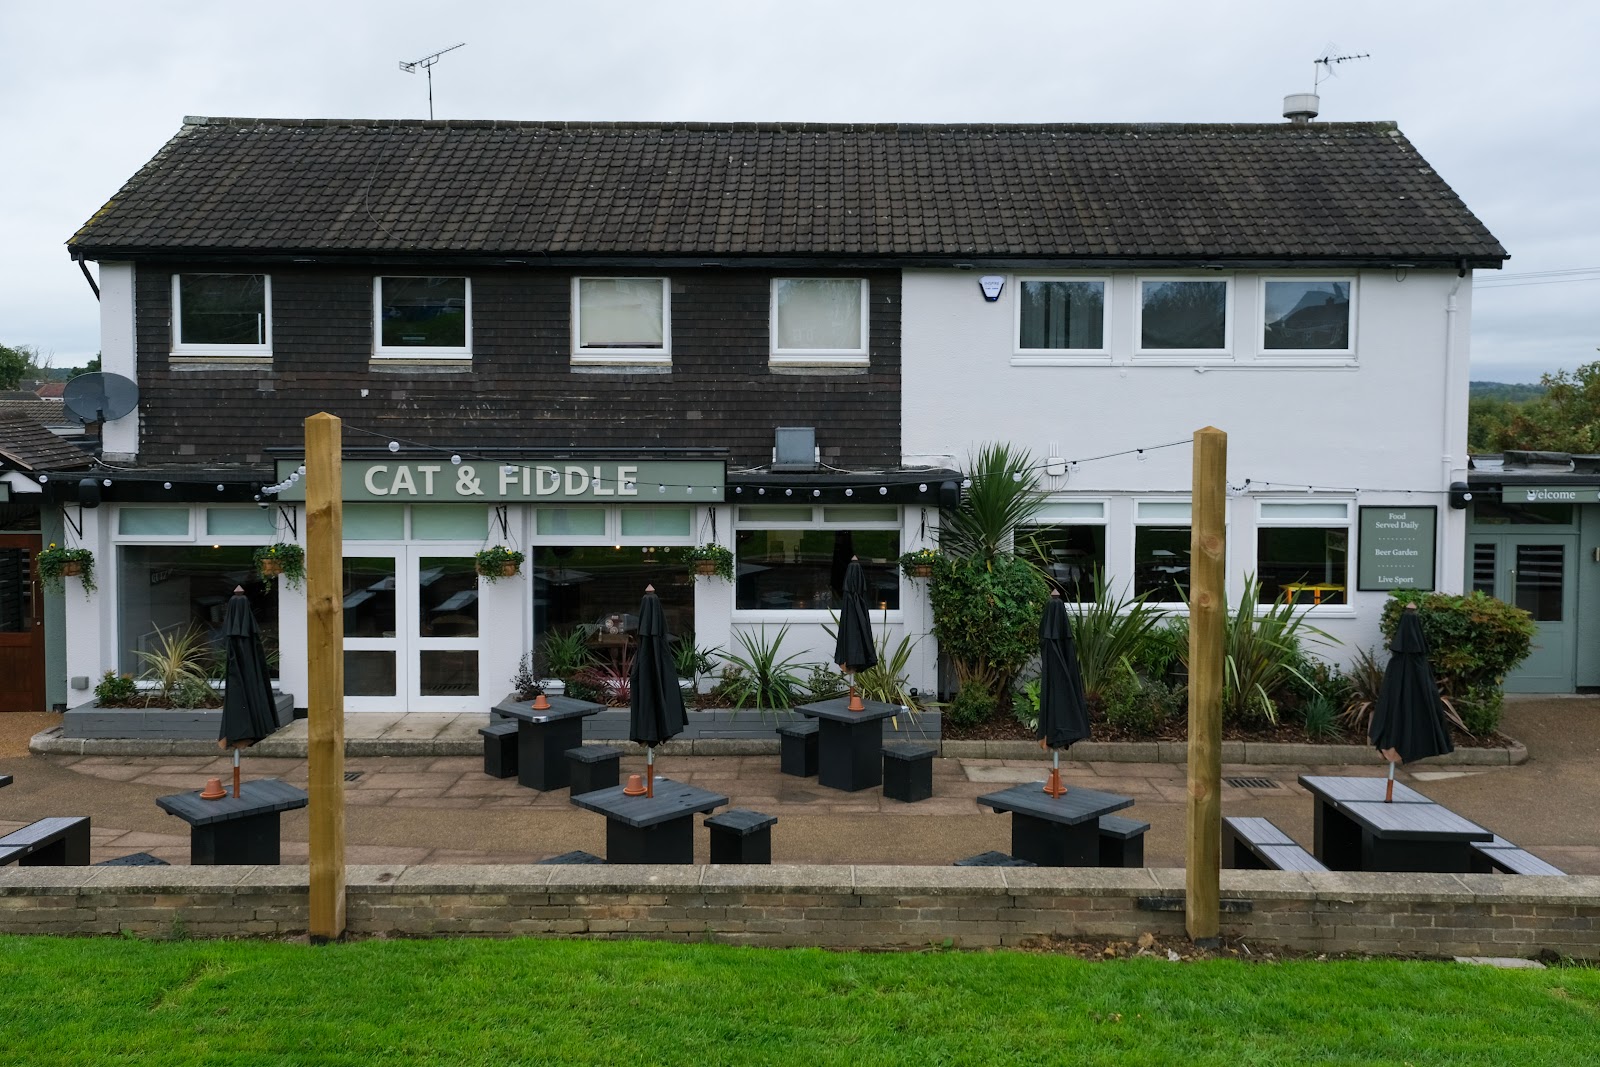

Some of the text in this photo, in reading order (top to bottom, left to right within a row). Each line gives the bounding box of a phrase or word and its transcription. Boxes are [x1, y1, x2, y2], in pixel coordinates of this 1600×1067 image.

[364, 465, 638, 496] CAT & FIDDLE
[1388, 512, 1406, 520] Food
[1375, 521, 1419, 530] Served Daily
[1375, 548, 1418, 556] Beer Garden
[1378, 575, 1414, 584] Live Sport
